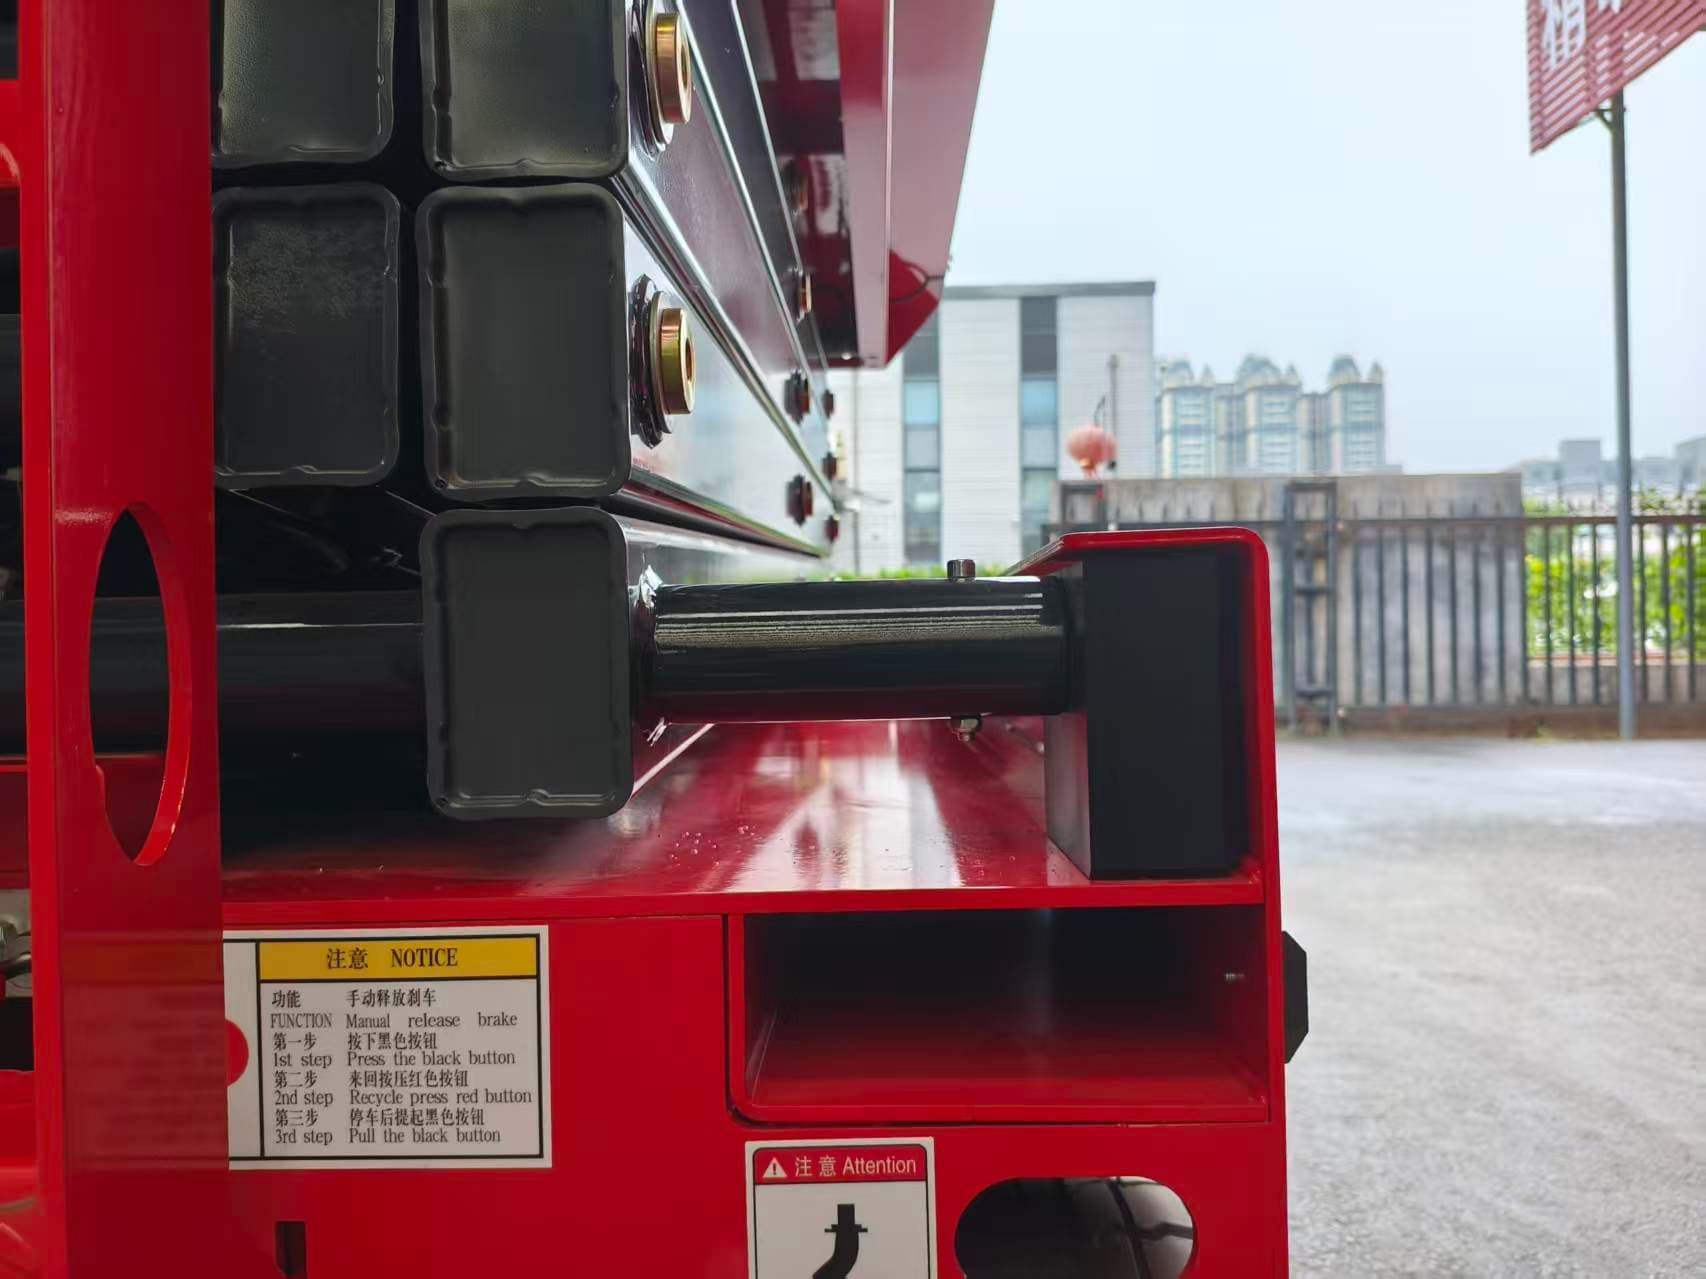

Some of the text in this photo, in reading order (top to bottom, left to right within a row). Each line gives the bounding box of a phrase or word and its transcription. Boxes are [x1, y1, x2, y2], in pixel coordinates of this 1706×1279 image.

[326, 947, 458, 970] 注意 NOTICE
[272, 990, 301, 1007] 功能
[346, 988, 437, 1008] 手动释放刹车
[270, 1013, 332, 1028] FUNCTION
[346, 1012, 518, 1028] Manual release brake
[273, 1032, 317, 1050] 第一步
[348, 1032, 437, 1050] 按下黑色按钮
[274, 1053, 332, 1069] 1st step
[348, 1050, 515, 1066] Press the black button
[274, 1070, 317, 1088] 第二步
[349, 1069, 468, 1088] 来回按压红色按钮
[274, 1090, 333, 1107] 2nd step
[350, 1088, 532, 1106] Recycle press red button
[275, 1109, 318, 1127] 第三步
[350, 1107, 485, 1126] 停车后提起黑色按钮
[275, 1129, 333, 1146] 3rd step
[349, 1127, 501, 1143] Pull the black button
[795, 1156, 916, 1177] 注意 Attention
